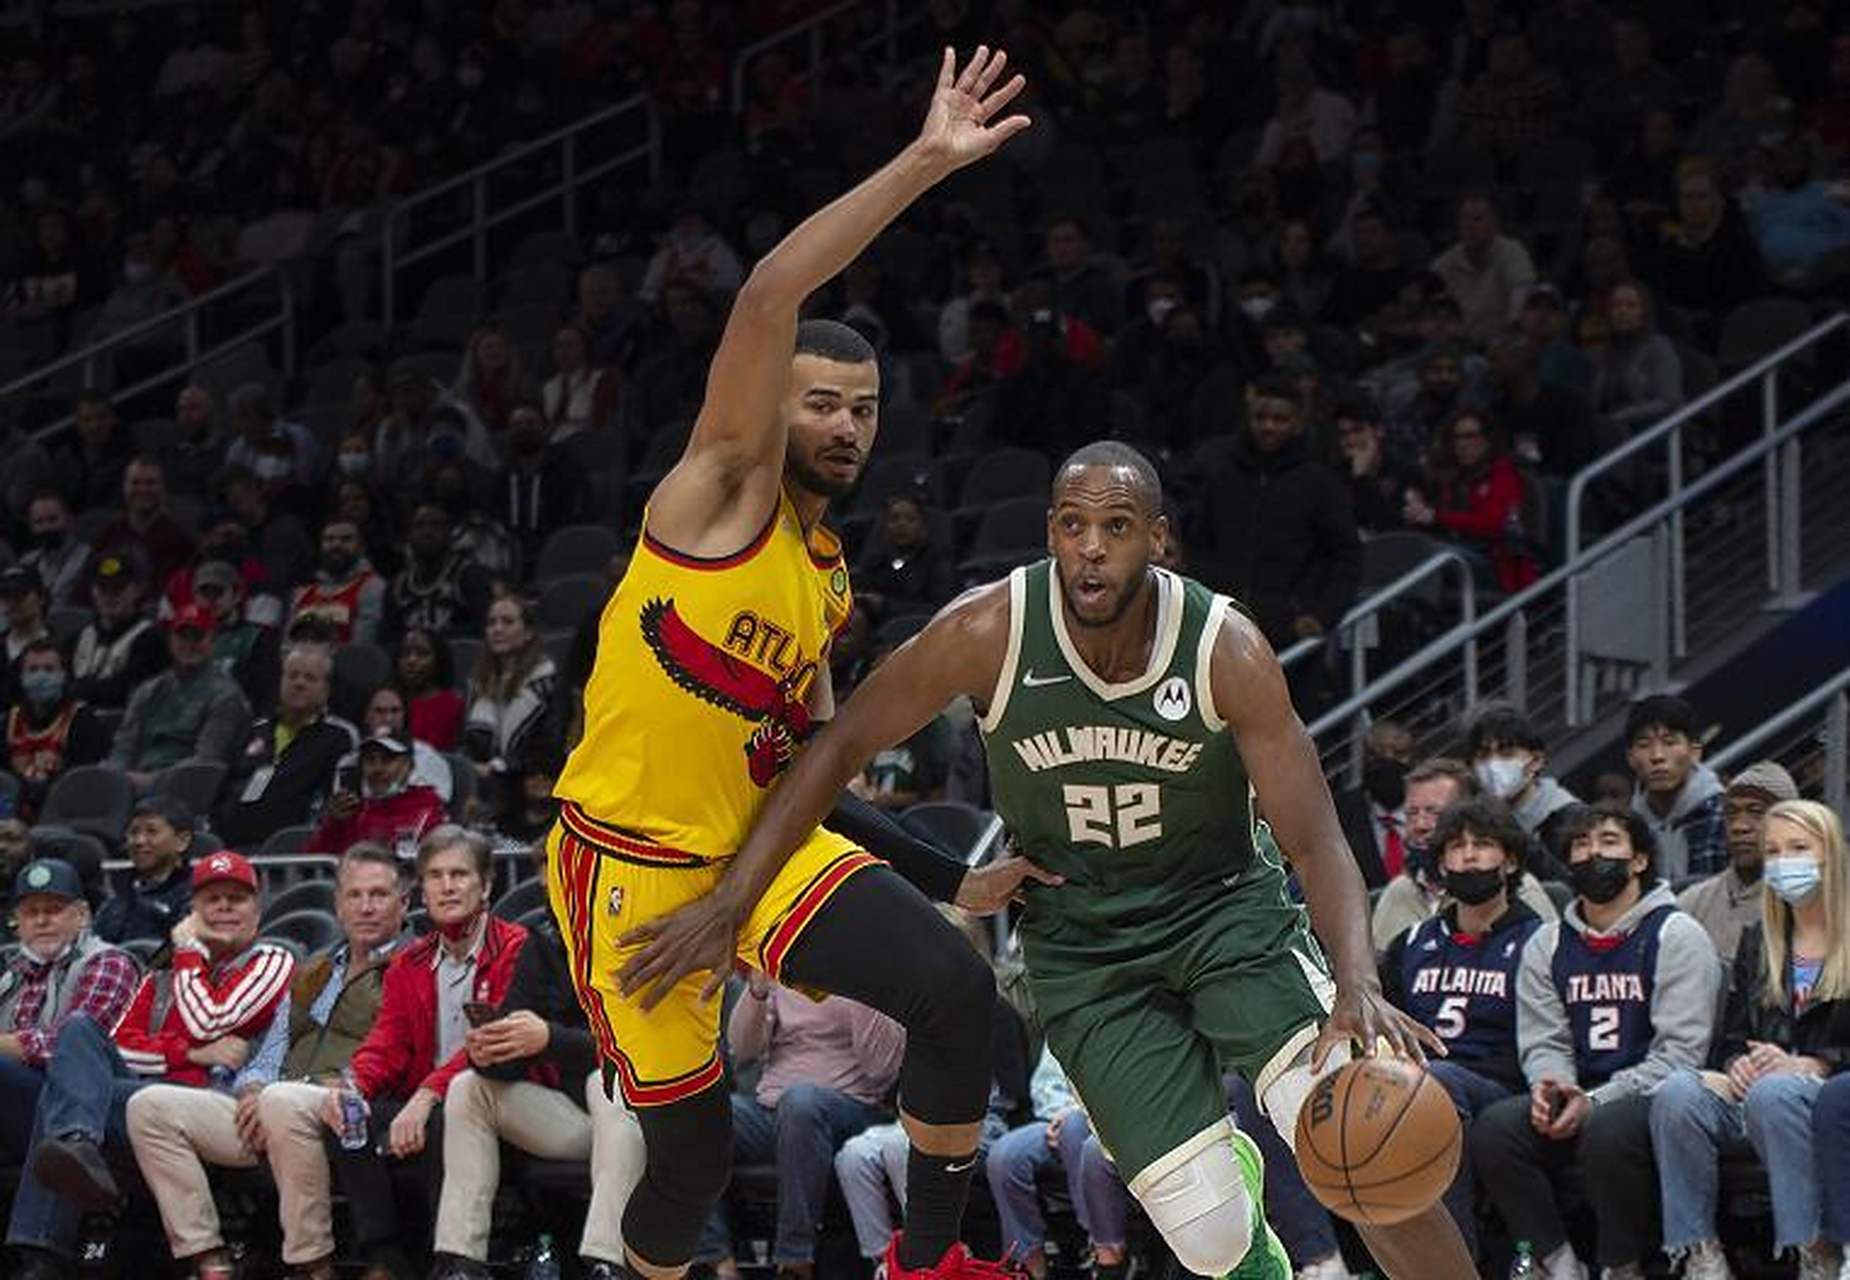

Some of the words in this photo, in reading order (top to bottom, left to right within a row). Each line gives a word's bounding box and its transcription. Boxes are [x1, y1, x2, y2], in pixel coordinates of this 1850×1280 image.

[1011, 725, 1204, 773] MILWAUKEE
[1062, 782, 1163, 849] 22
[1565, 973, 1644, 1004] TLANA
[1434, 997, 1468, 1038] 5
[1588, 1007, 1619, 1050] 2
